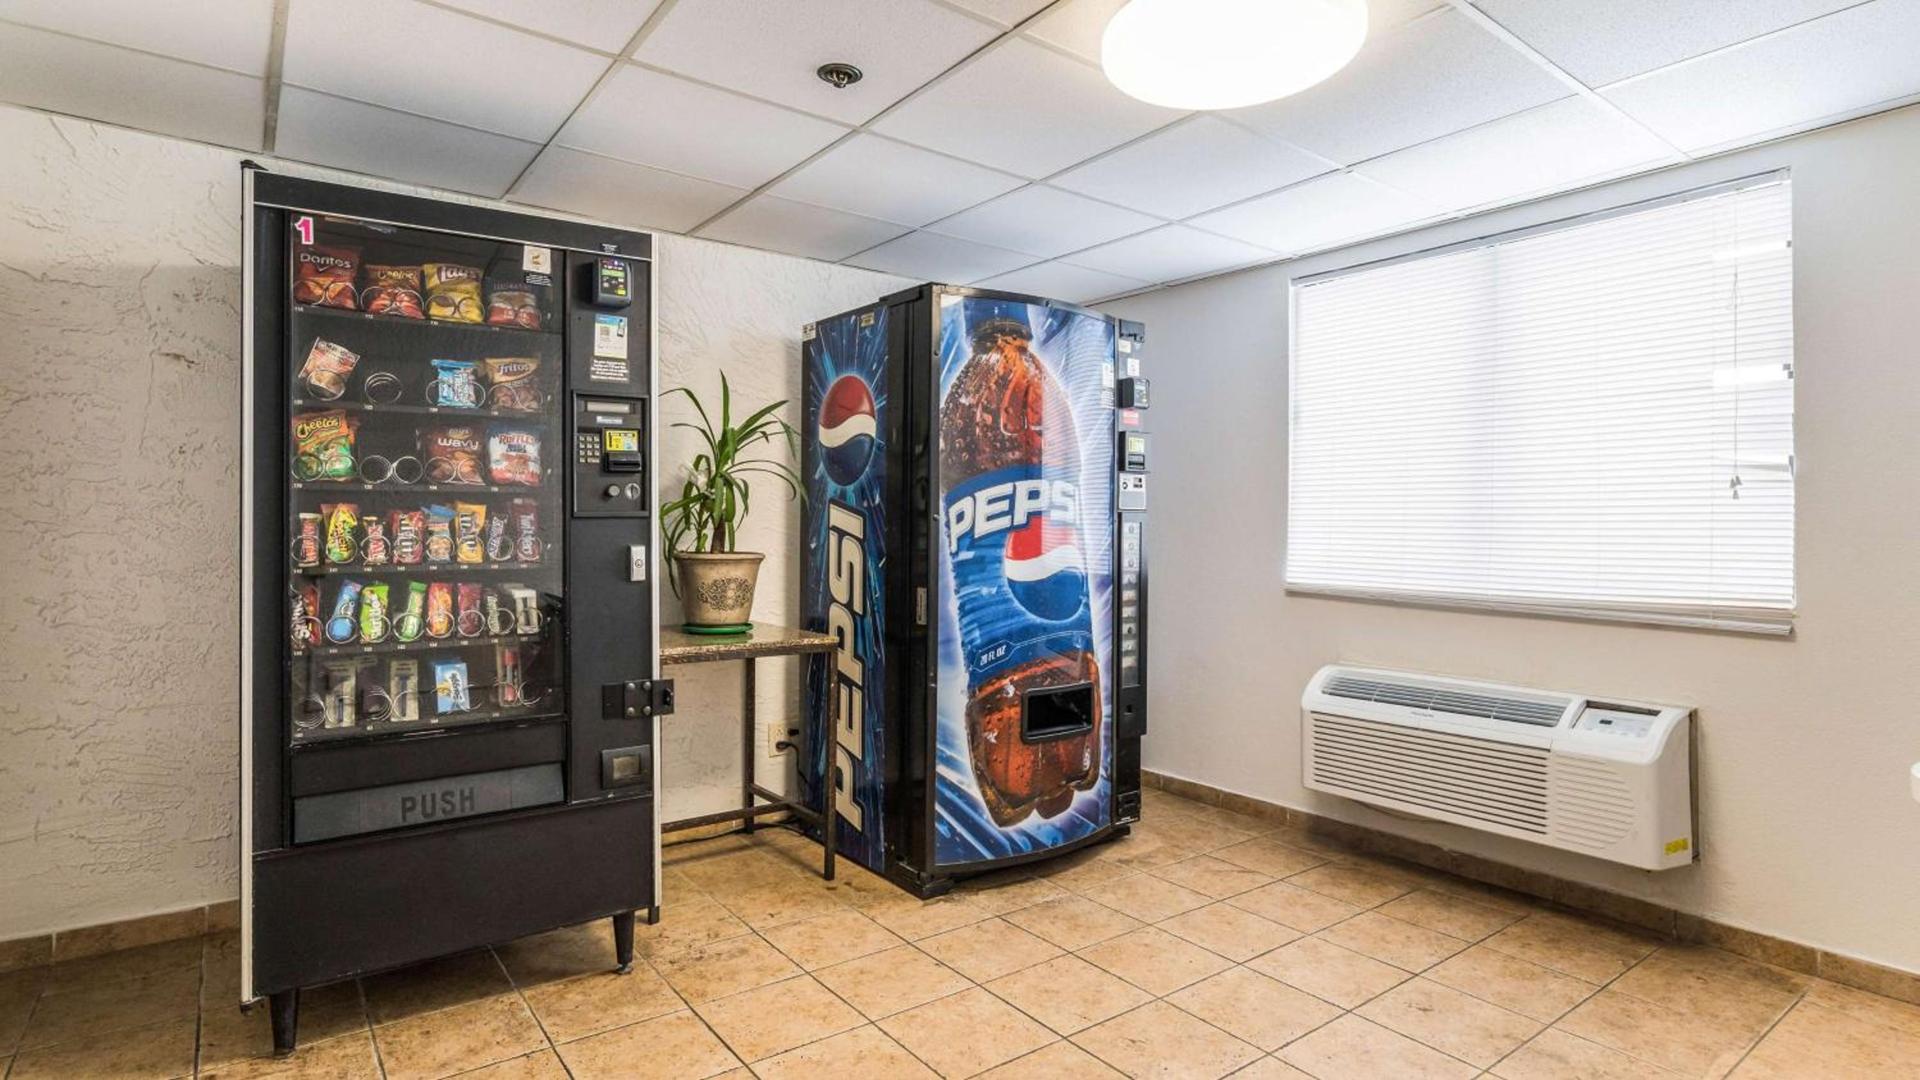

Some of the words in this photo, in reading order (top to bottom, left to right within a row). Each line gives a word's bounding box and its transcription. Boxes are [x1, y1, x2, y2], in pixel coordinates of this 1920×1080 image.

[294, 216, 314, 245] 1
[300, 252, 352, 269] Doritos
[296, 416, 339, 439] Cheetos
[996, 644, 1007, 657] OZ
[829, 503, 863, 833] PEPSI
[401, 787, 475, 823] PUSH
